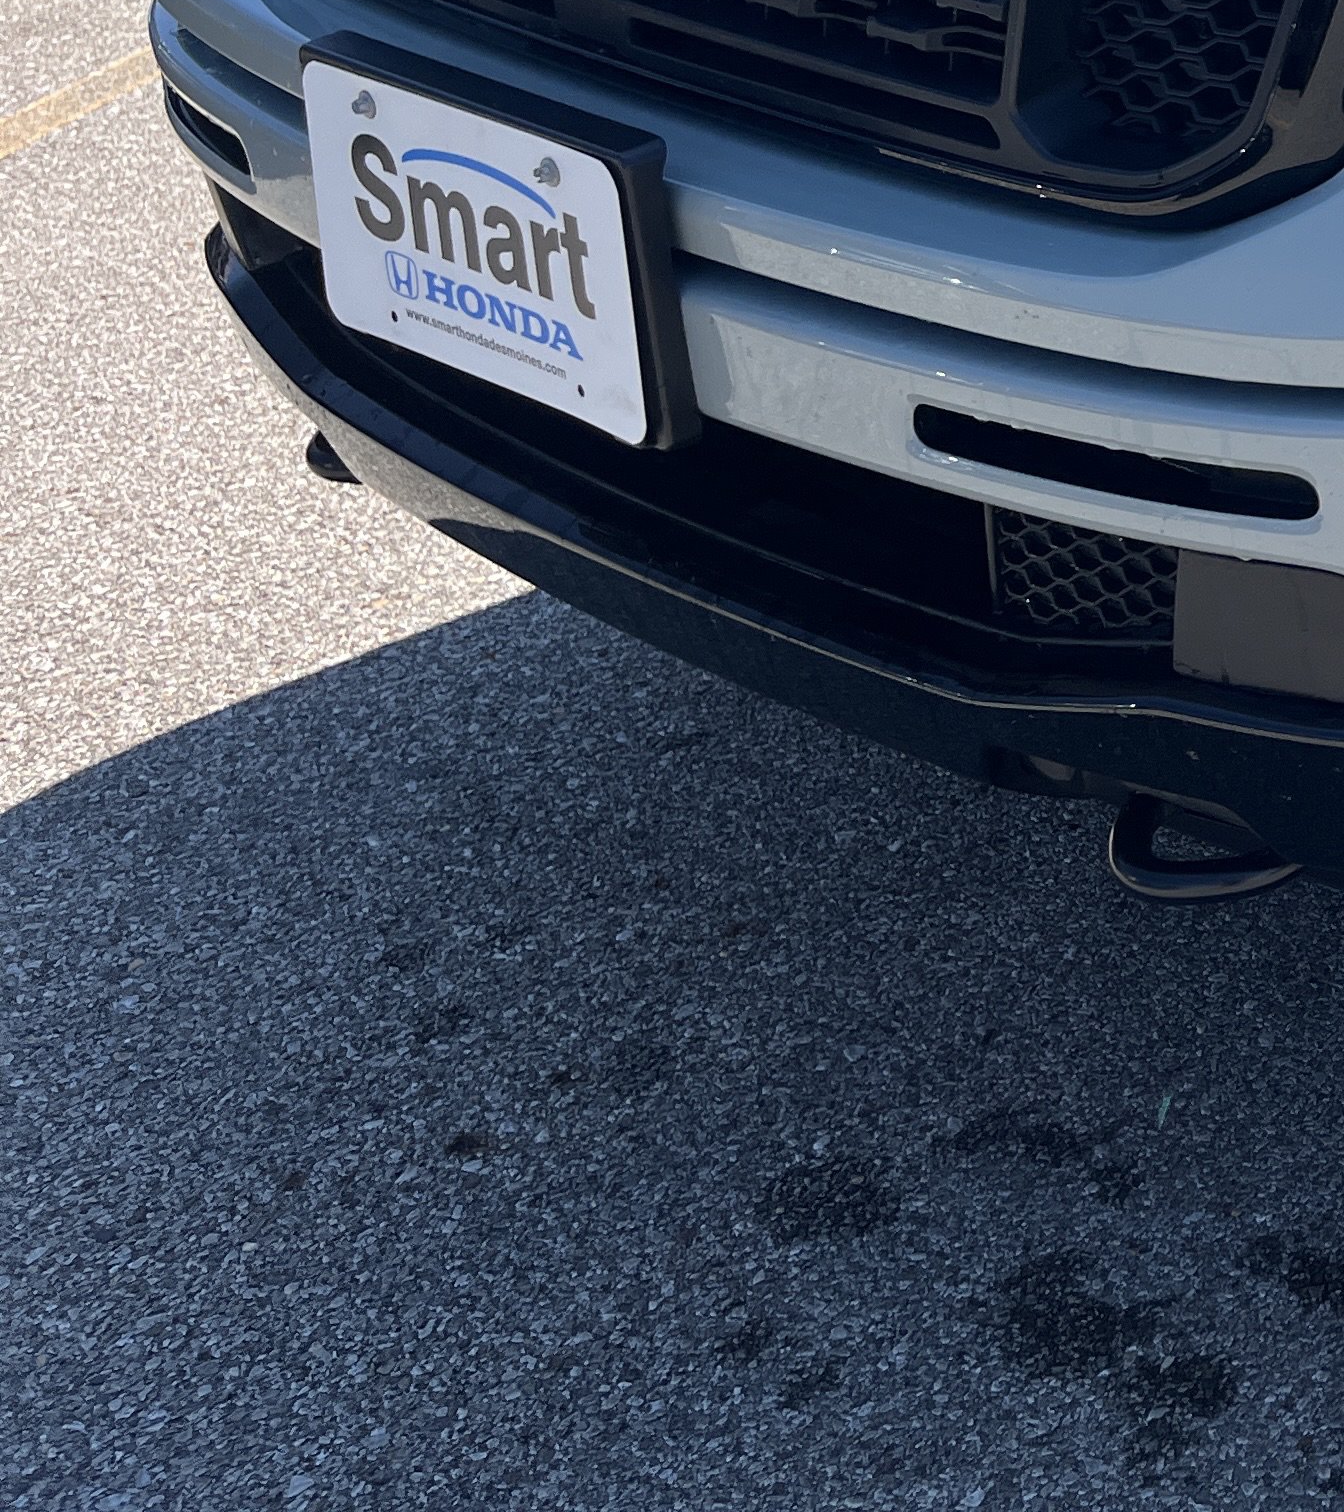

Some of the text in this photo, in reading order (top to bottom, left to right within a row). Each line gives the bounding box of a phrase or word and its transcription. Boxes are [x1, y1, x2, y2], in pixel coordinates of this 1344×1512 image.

[351, 134, 597, 320] Smart
[405, 308, 567, 379] www.smarthondadesmoines.com
[422, 269, 584, 361] HONDA
